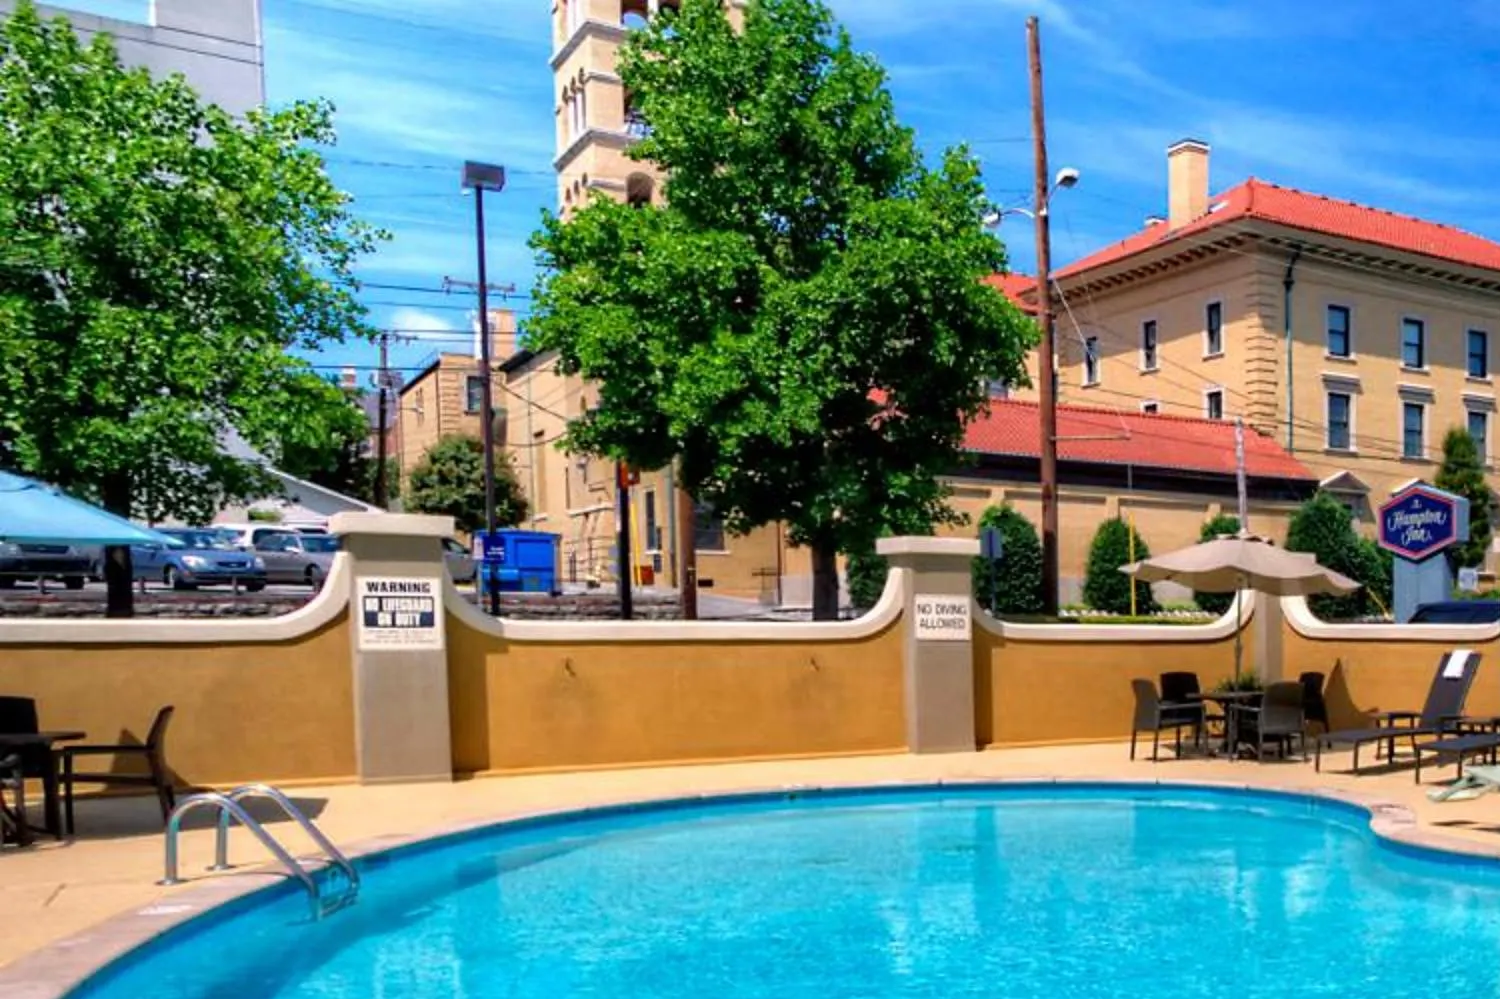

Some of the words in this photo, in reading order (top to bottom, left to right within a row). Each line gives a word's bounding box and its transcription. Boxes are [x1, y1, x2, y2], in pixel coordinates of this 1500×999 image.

[1388, 509, 1446, 532] Hampton
[1402, 526, 1432, 546] Inn
[366, 582, 430, 592] WARNING
[917, 603, 932, 614] NO
[936, 604, 967, 615] DIVING
[920, 618, 965, 629] ALLOWED
